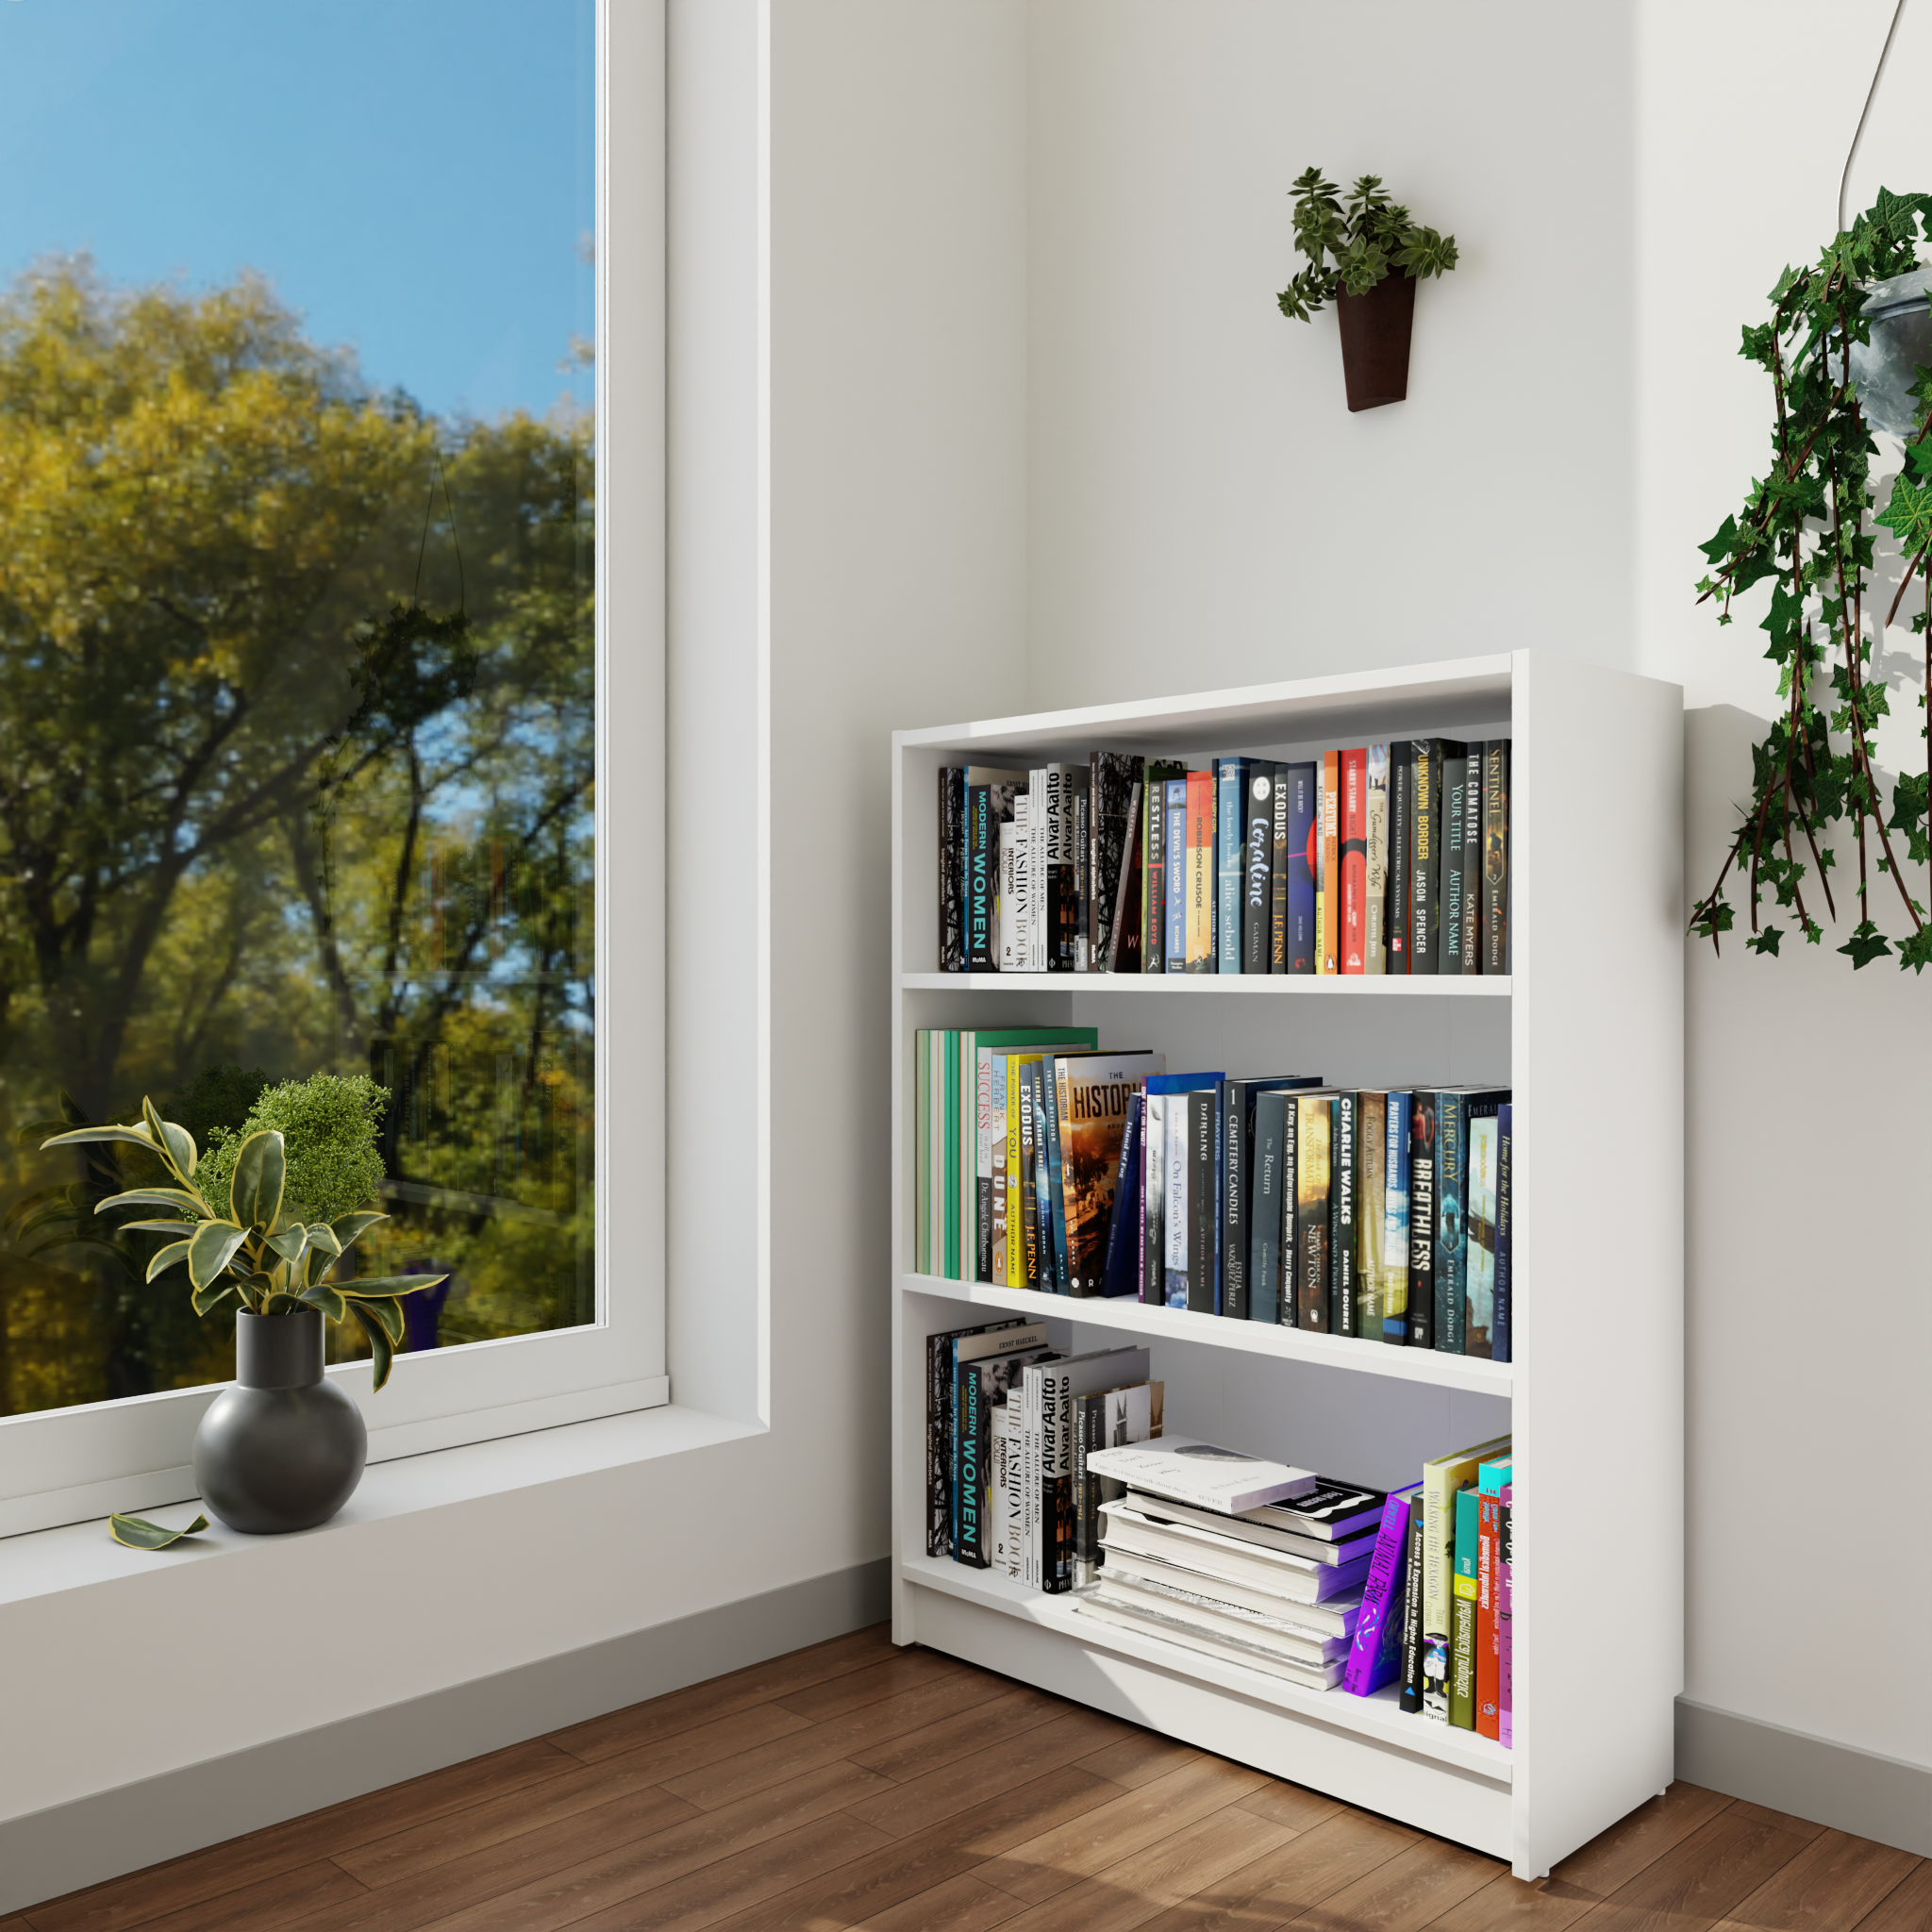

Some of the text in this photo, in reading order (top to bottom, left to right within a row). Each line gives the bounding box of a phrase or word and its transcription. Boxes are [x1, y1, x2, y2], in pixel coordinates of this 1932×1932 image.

[1274, 783, 1286, 841] EXODUS
[1418, 755, 1429, 859] UNKNOWN BORDER
[1467, 754, 1479, 843] THE COMATOSE
[1489, 749, 1502, 817] SENTINEL
[1128, 800, 1137, 838] WOLFISH
[1151, 786, 1159, 859] RESTLESS
[1325, 791, 1336, 837] PERFUME
[1451, 785, 1464, 851] YOUR TITLE
[1015, 798, 1027, 968] THE FASHION BOOK
[1250, 818, 1269, 908] Coraline
[974, 853, 985, 948] WOMEN
[1224, 880, 1235, 960] alice sebold
[1416, 870, 1426, 954] JASON SPENCER
[1448, 869, 1461, 956] AUTHOR NAME
[1465, 893, 1474, 966] KATE MYERS
[1274, 914, 1283, 964] J.F. PENN
[977, 1062, 991, 1129] SUCCESS
[1010, 1110, 1016, 1119] OF
[1021, 1085, 1033, 1146] EXODUS
[1058, 1082, 1069, 1122] HISTORIAN
[1286, 1111, 1295, 1125] Key,
[1118, 1121, 1133, 1179] Island of Fog
[1199, 1103, 1208, 1160] DARLING
[1286, 1140, 1294, 1154] Egg,
[1287, 1127, 1293, 1138] an
[1365, 1116, 1375, 1179] FOGGY AUTUMN
[1443, 1104, 1457, 1182] MERCURY
[1228, 1115, 1239, 1224] CEMETERY CANDLES
[1263, 1154, 1274, 1194] Return
[1286, 1168, 1294, 1212] Unfortunate
[1287, 1157, 1293, 1166] an
[1305, 1113, 1315, 1209] TRANSFORMATIONS
[1341, 1098, 1351, 1224] CHARLIE WALKS
[1499, 1136, 1510, 1237] Home for the Holidays
[980, 1196, 989, 1220] Angele
[994, 1155, 1006, 1230] DUNE
[1170, 1160, 1181, 1266] On Falcon's Wings
[1411, 1158, 1433, 1271] BREATHLESS
[1024, 1225, 1037, 1279] J.F. PENN
[1285, 1213, 1293, 1242] Remark
[1307, 1224, 1316, 1289] NEWTON
[1227, 1243, 1236, 1281] VAZQUEZ
[1284, 1249, 1293, 1303] Harry Connolly
[1019, 1336, 1038, 1345] HAECKEL
[1497, 1298, 1506, 1325] NAME
[963, 1440, 975, 1543] WOMEN
[1008, 1395, 1022, 1579] THE FASHION BOOK
[1024, 1486, 1030, 1498] OF
[1035, 1489, 1040, 1503] OF
[1382, 1500, 1400, 1529] ORWELL
[1365, 1533, 1397, 1604] ANIMAL FARM
[1414, 1532, 1423, 1558] Access
[1428, 1490, 1440, 1599] WALKING THE HEXAGON
[1410, 1569, 1420, 1607] Expansion
[1411, 1609, 1418, 1618] in
[1407, 1620, 1418, 1644] Higher
[1407, 1645, 1416, 1684] Education
